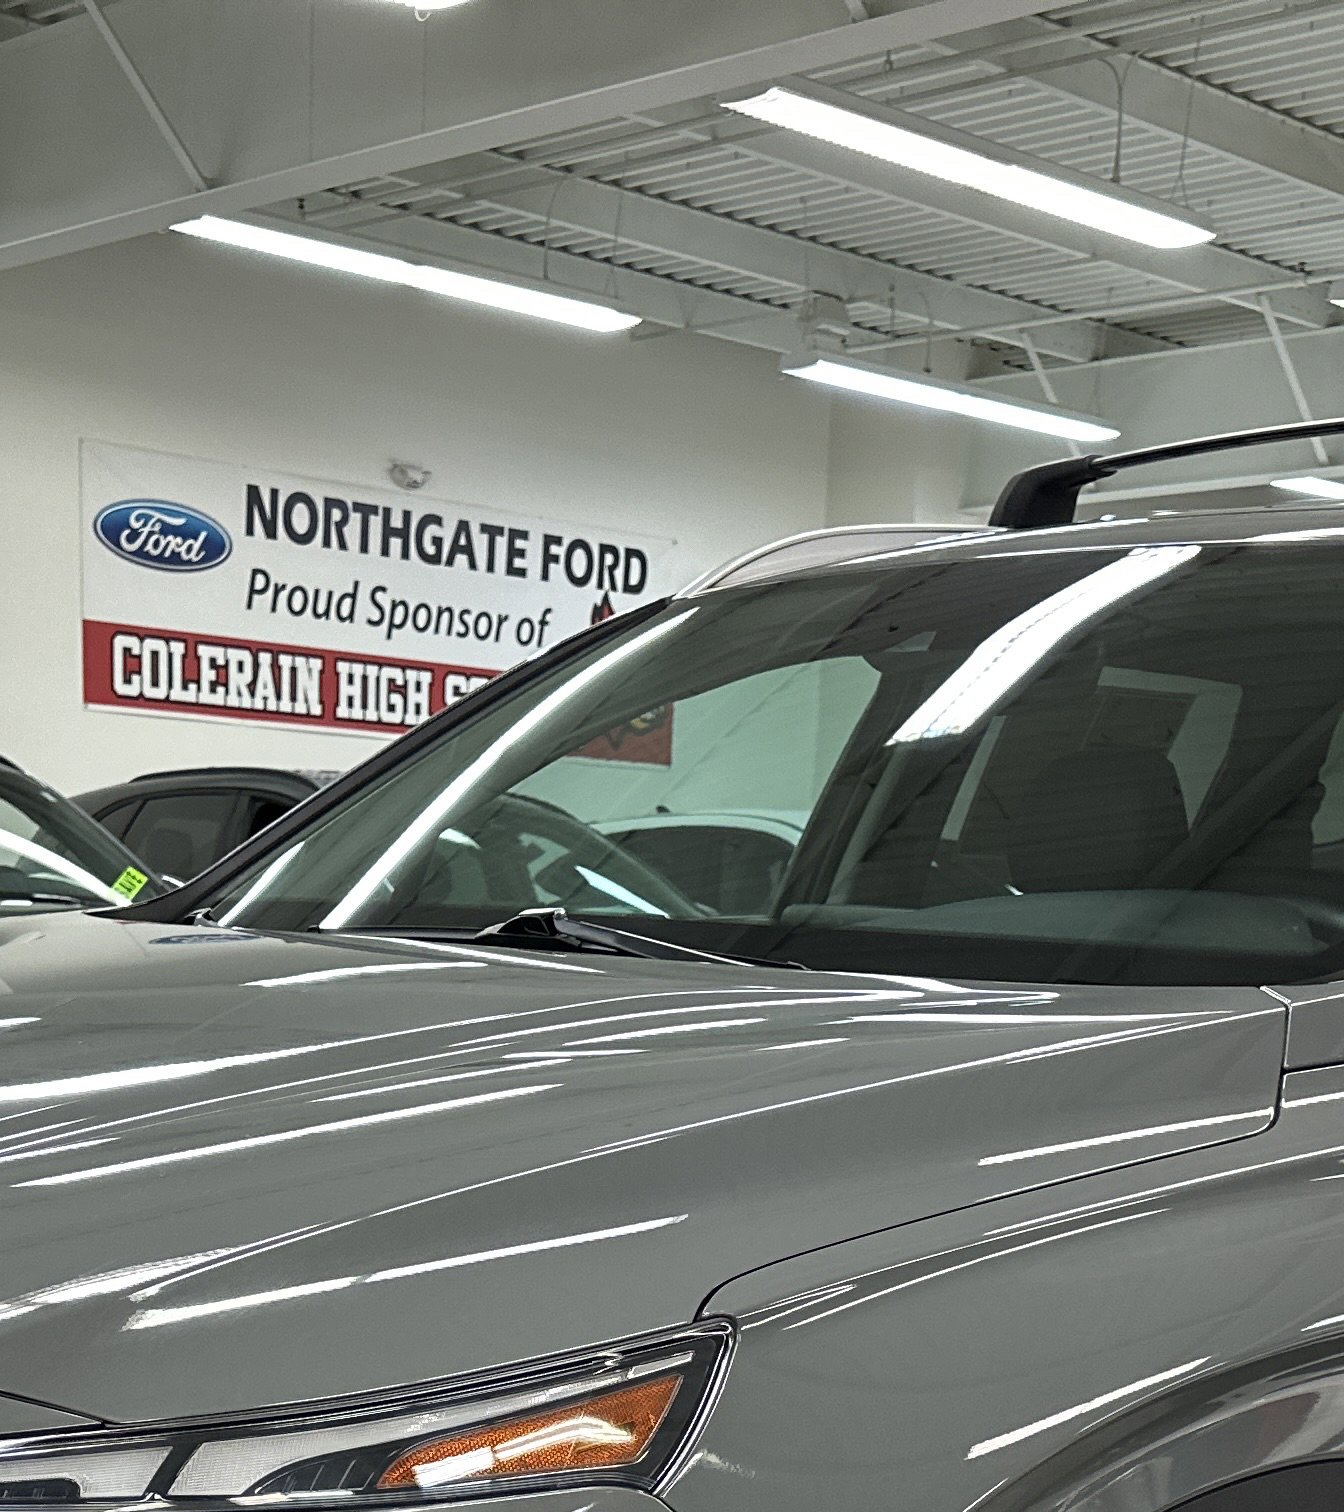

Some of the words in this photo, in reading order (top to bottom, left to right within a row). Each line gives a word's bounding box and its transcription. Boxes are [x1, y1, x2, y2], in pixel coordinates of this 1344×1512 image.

[118, 507, 209, 564] Ford
[244, 483, 529, 579] NORTHGATE
[540, 533, 648, 596] FORD
[245, 567, 361, 624] Proud
[366, 584, 509, 643] Sponsor
[517, 607, 553, 648] of
[111, 633, 324, 718] COLERAIN
[335, 659, 433, 727] HIGH
